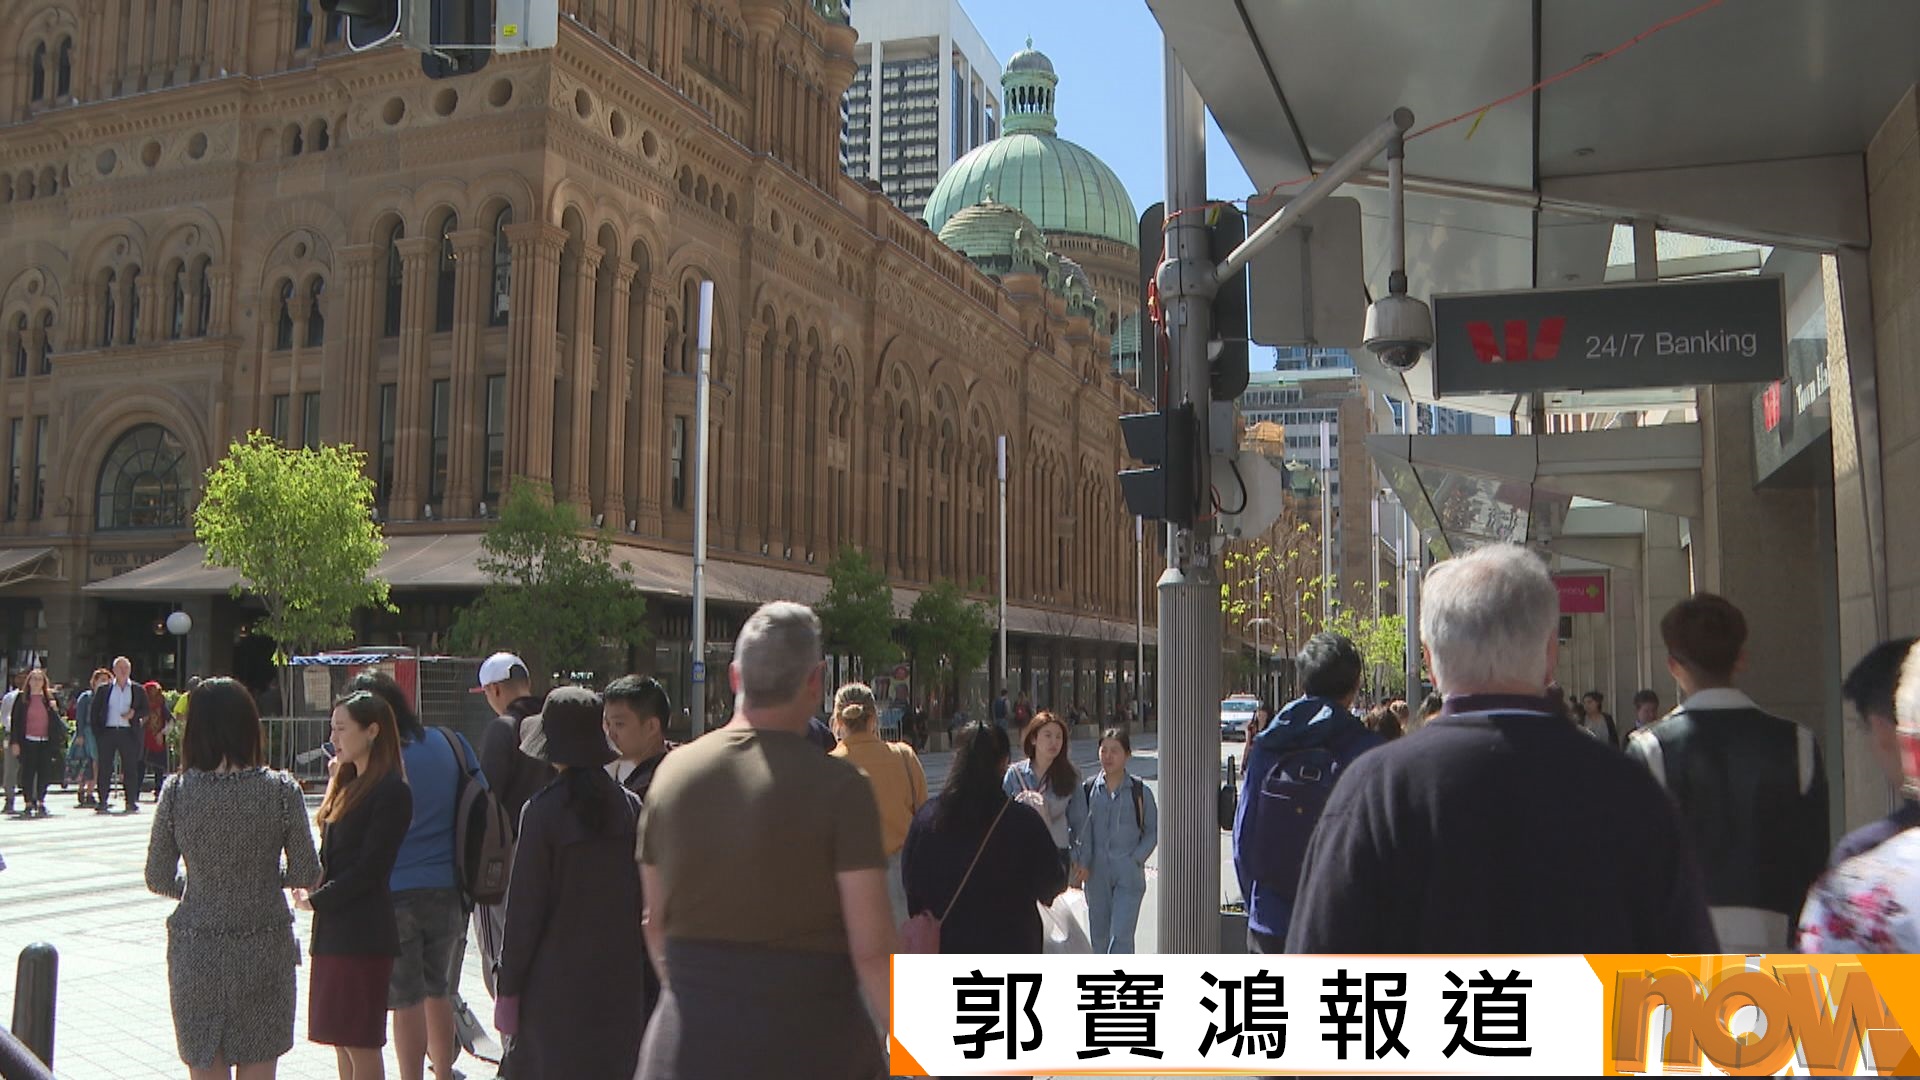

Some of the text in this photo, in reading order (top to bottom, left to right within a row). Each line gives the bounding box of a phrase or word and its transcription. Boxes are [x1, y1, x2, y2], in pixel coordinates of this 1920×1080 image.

[1585, 329, 1758, 360] 24/7 Banking
[1796, 383, 1816, 415] Town
[93, 552, 127, 566] QUEEN
